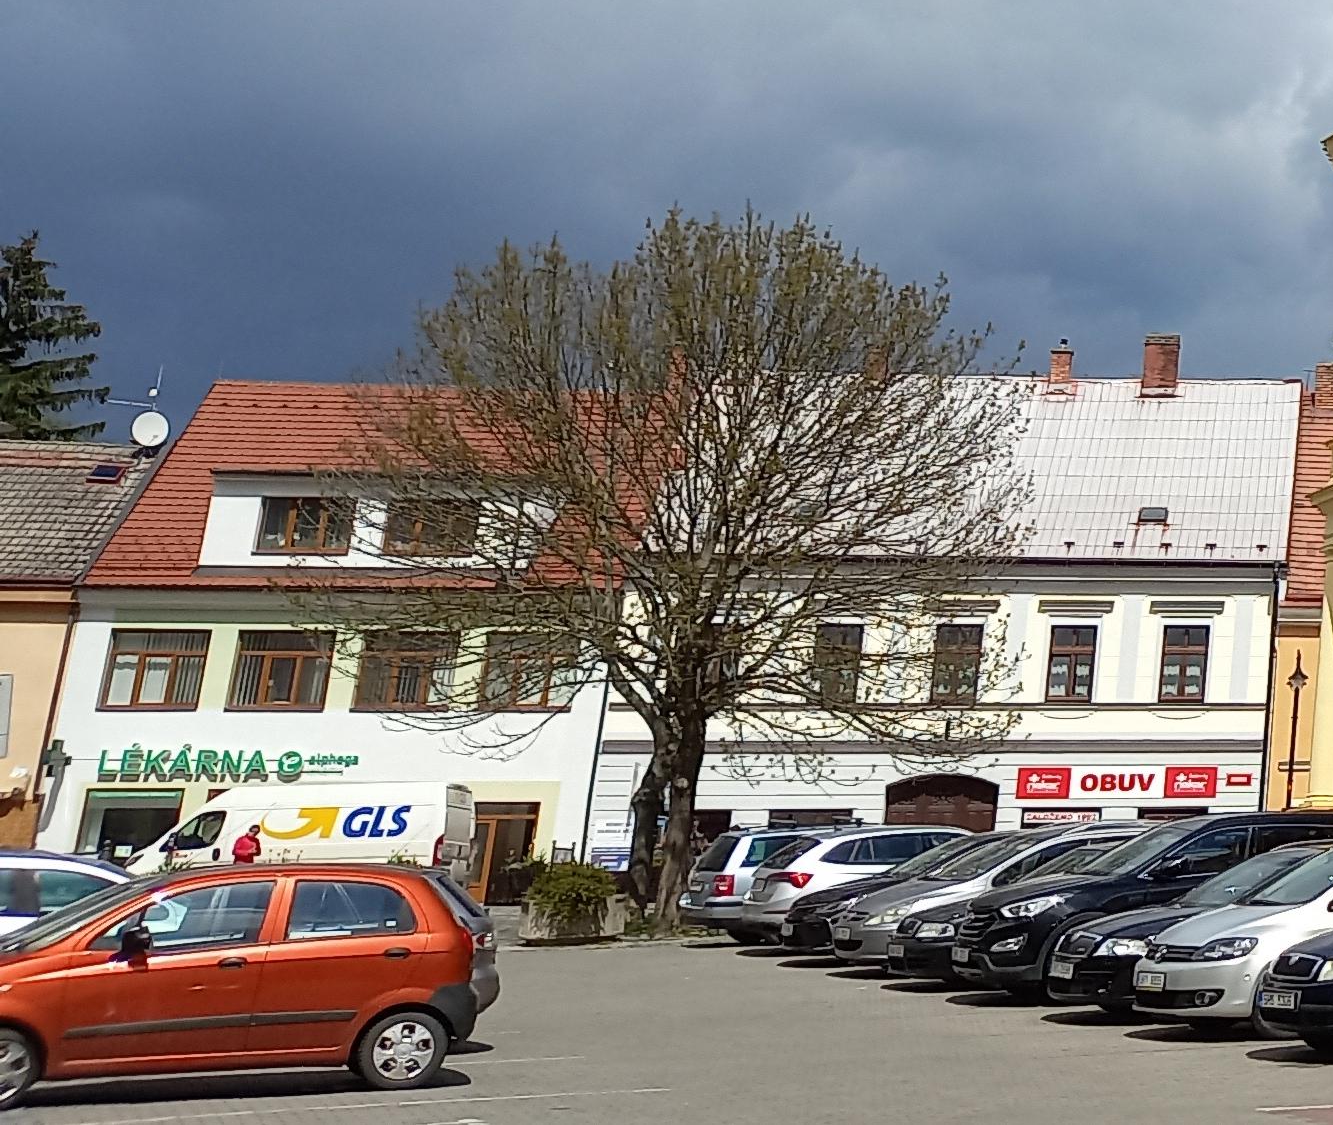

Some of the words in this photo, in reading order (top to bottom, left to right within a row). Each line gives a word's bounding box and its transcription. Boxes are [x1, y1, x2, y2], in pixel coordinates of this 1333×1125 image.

[97, 742, 268, 776] LÉKÁRNA
[1080, 773, 1156, 792] OBUV
[342, 805, 412, 838] GLS
